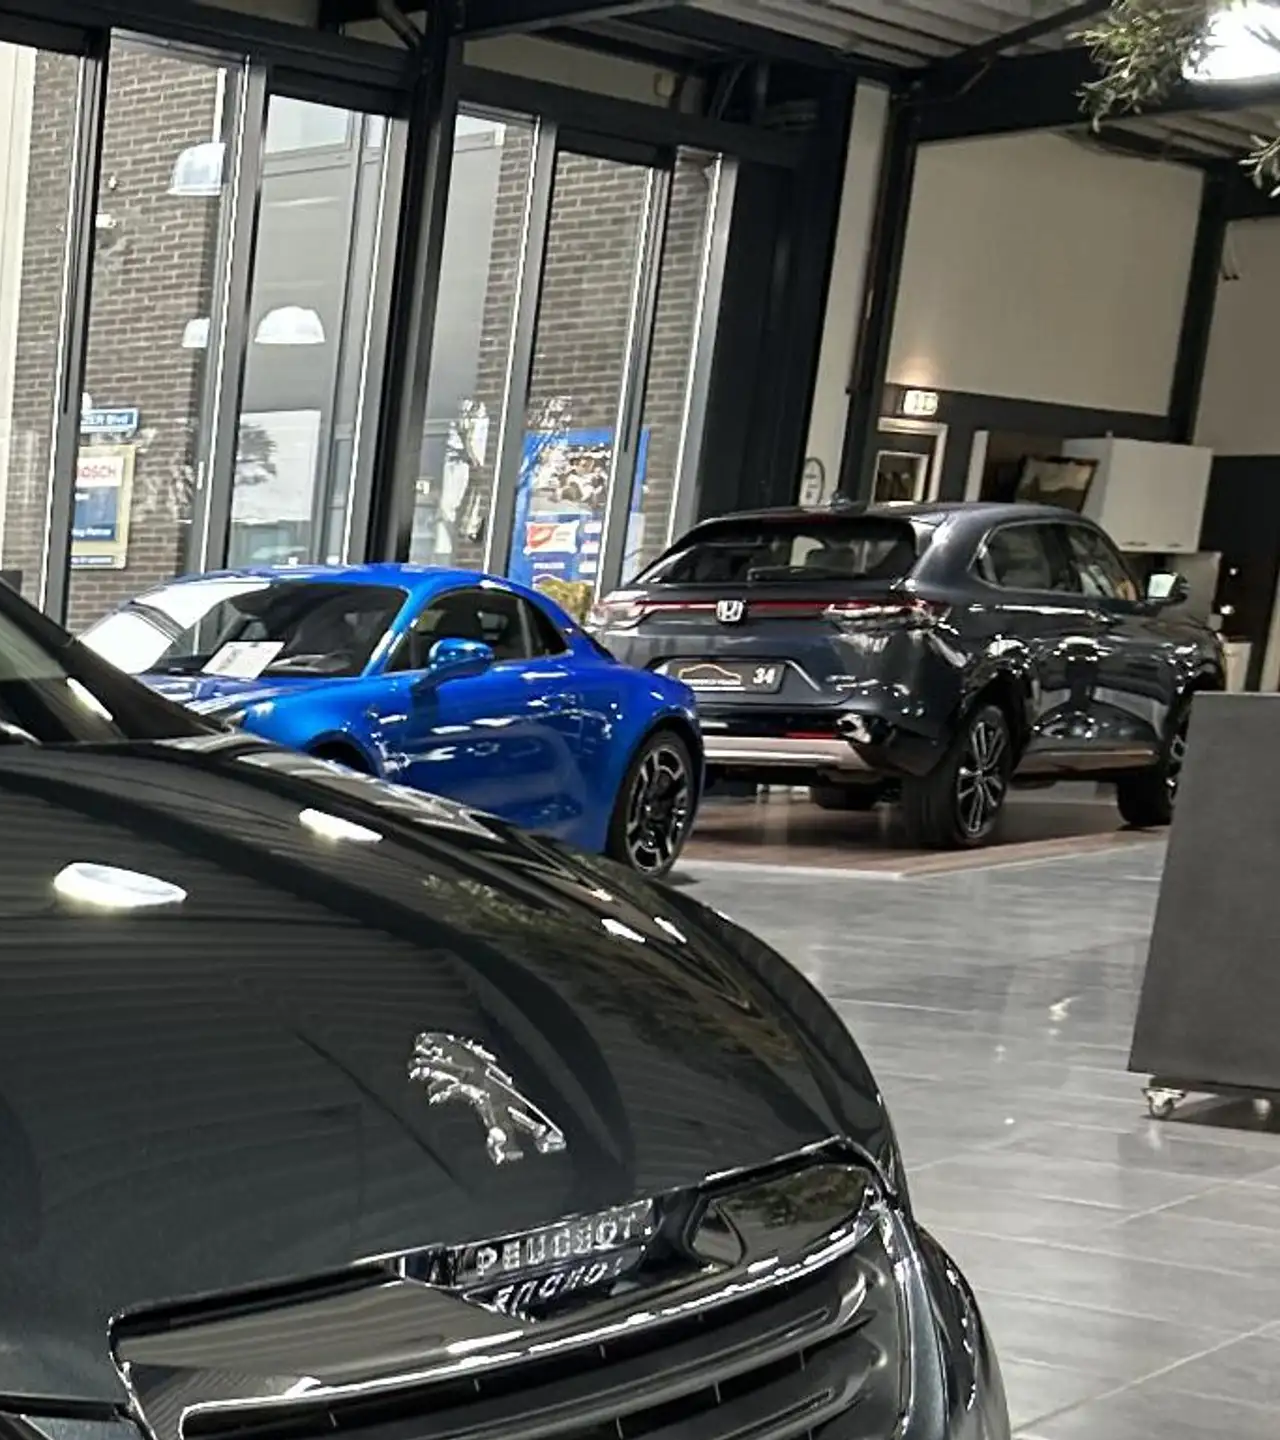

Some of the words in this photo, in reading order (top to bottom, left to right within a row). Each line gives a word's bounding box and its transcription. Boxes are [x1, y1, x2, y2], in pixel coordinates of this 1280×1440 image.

[77, 464, 116, 478] OSCH
[753, 667, 776, 684] 34
[476, 1212, 637, 1277] PEUGEOT
